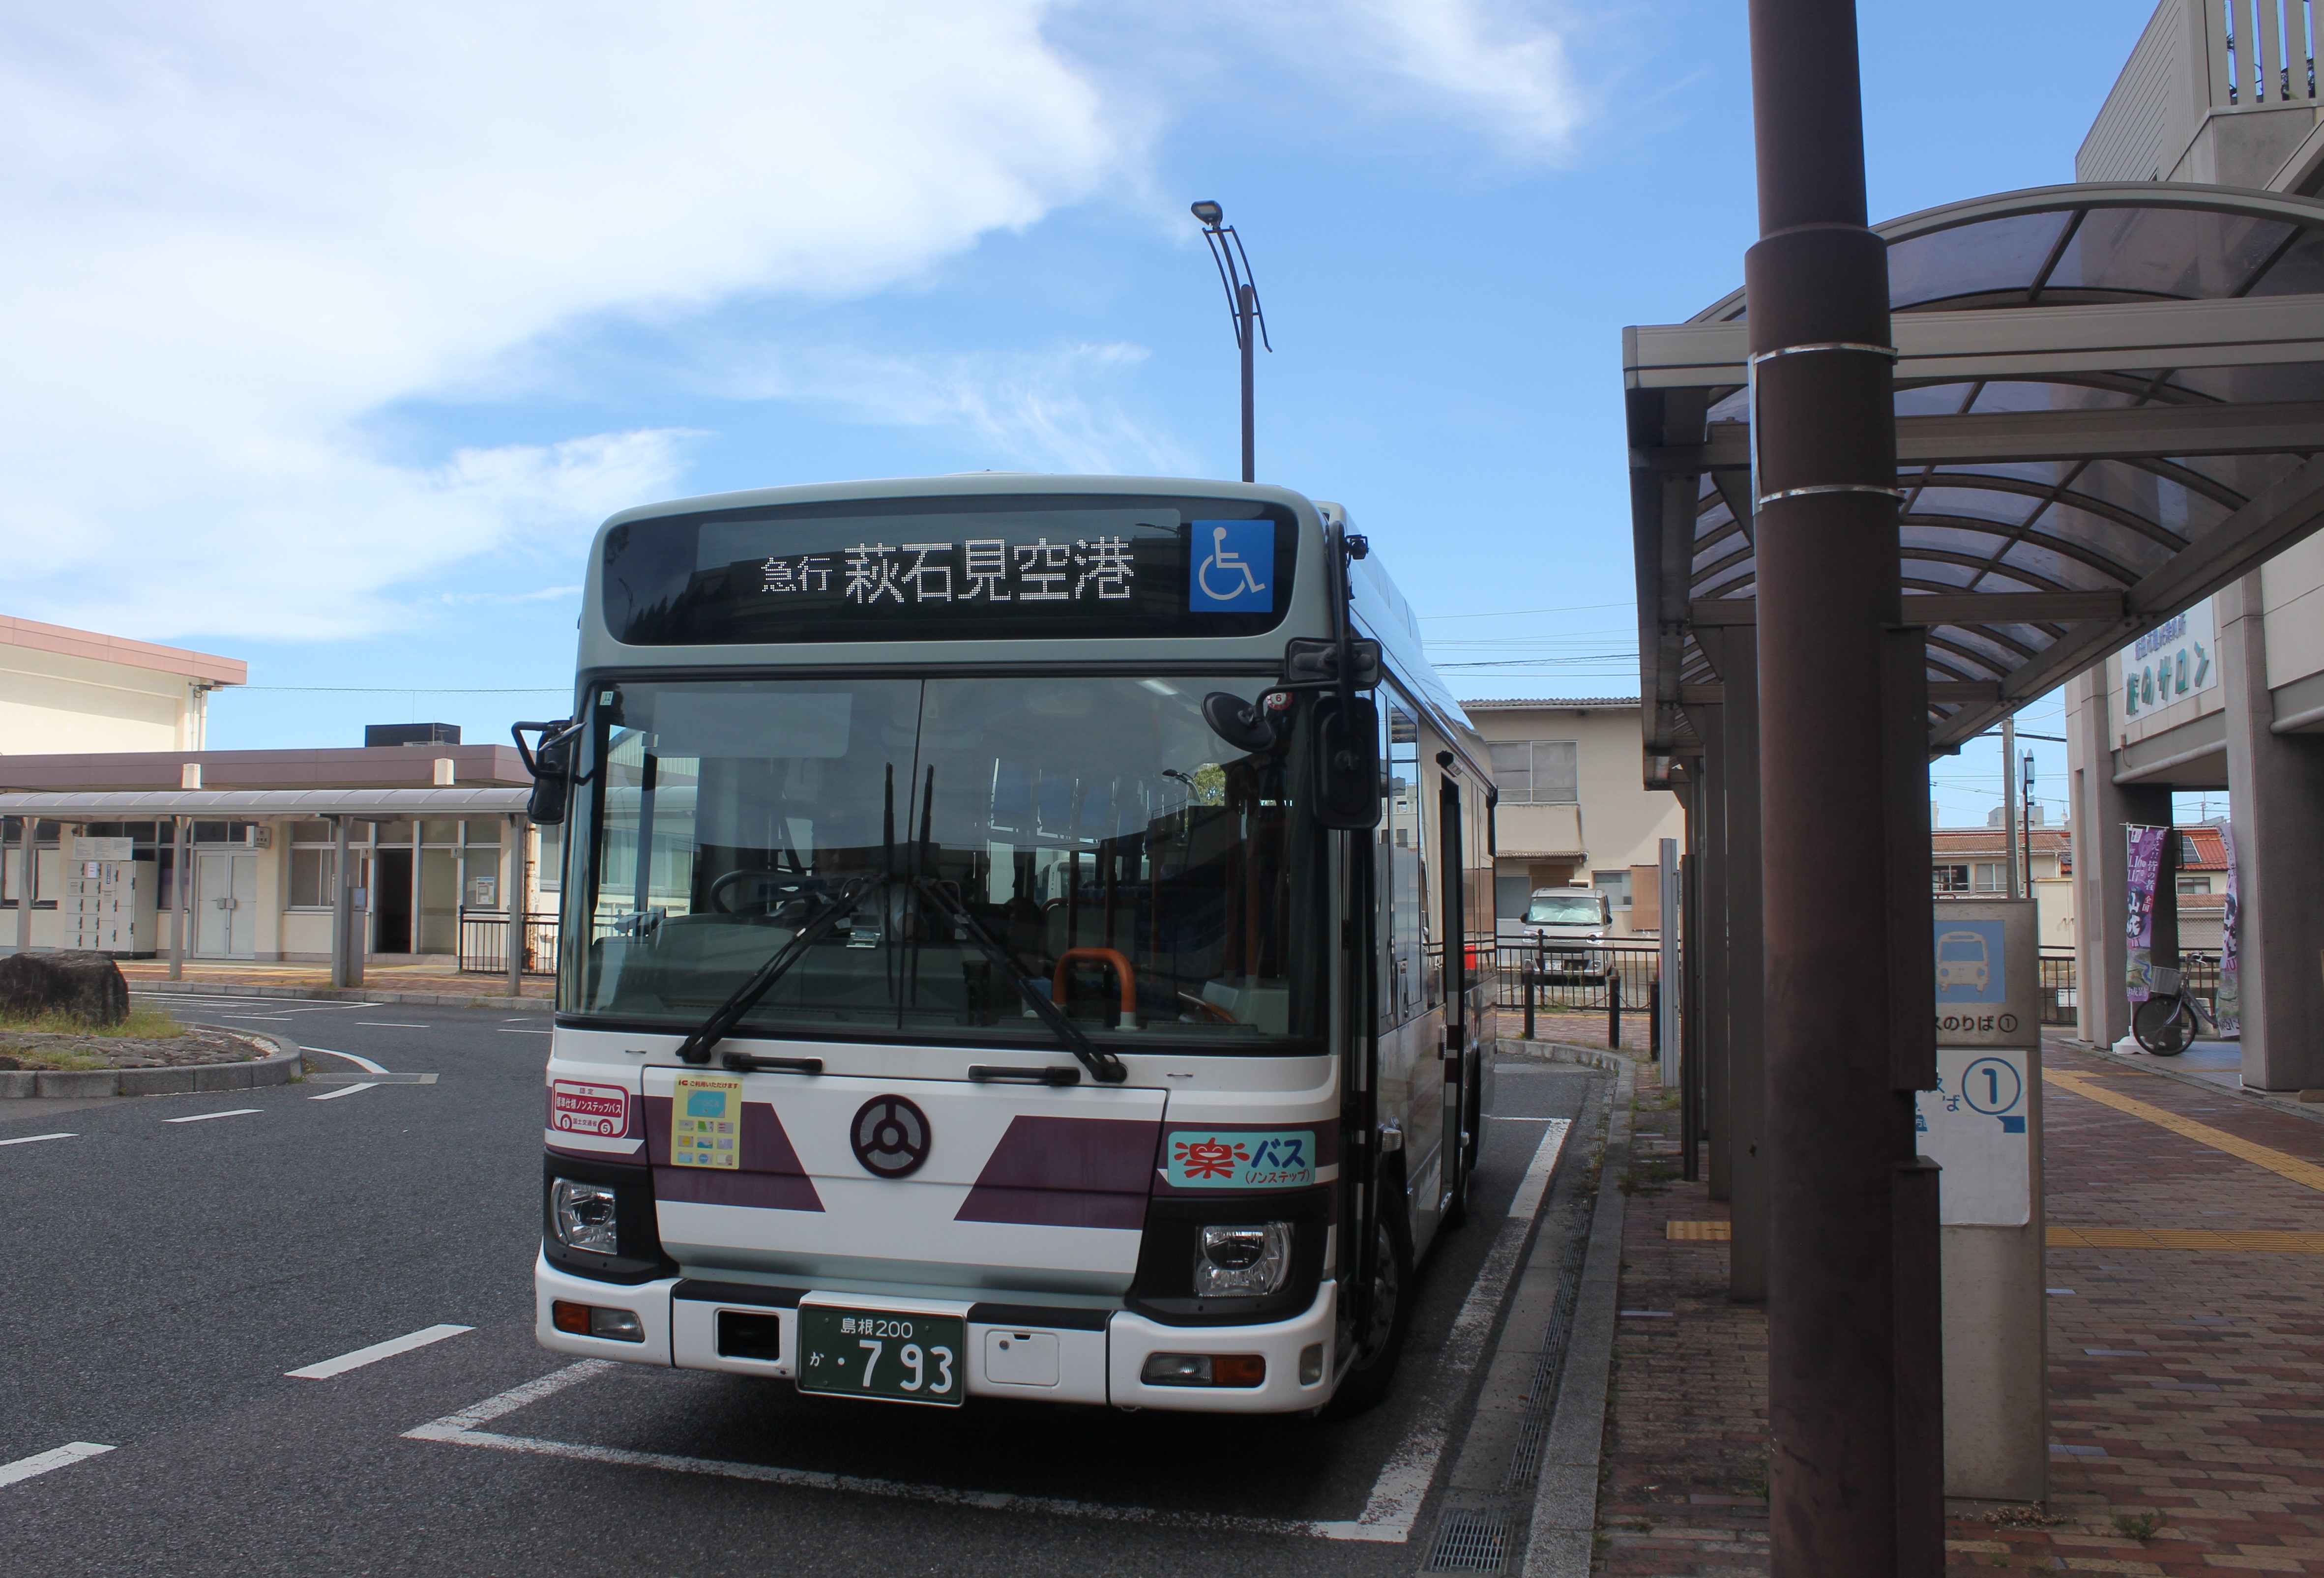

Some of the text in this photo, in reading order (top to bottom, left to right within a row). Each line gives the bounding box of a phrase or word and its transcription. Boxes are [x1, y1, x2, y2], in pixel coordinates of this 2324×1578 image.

[761, 535, 1134, 604] 急行 萩石見空港
[2142, 895, 2152, 912] 全国
[690, 1081, 738, 1089] ご利用いただけます
[556, 1096, 621, 1114] 標準仕様ノンステップバス
[573, 1118, 598, 1127] 国土交通省
